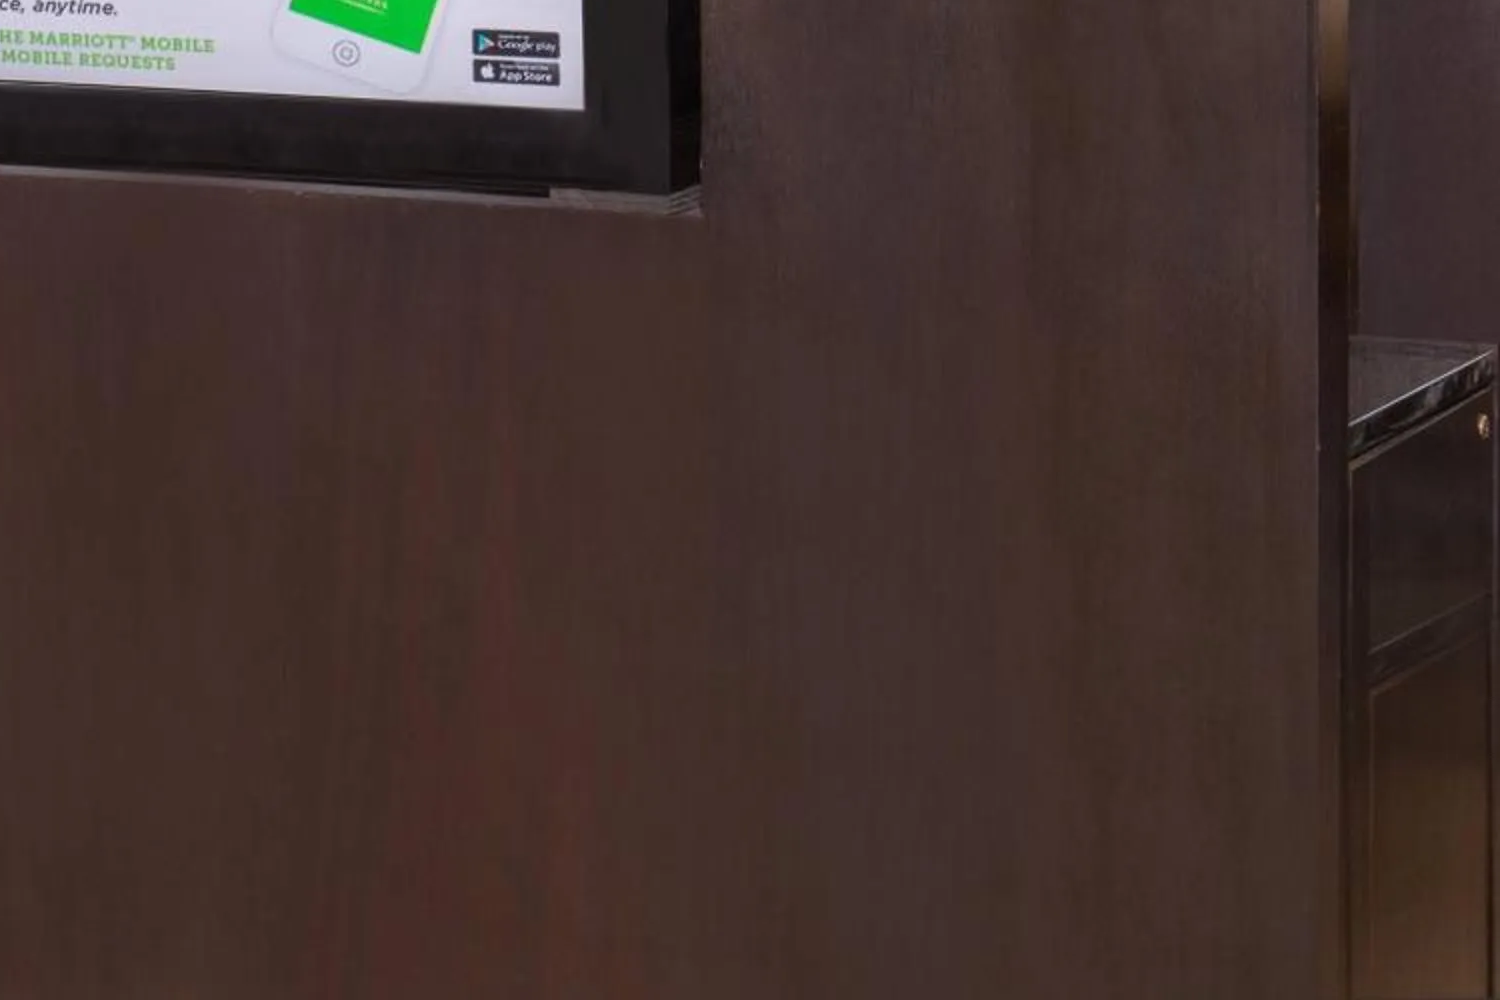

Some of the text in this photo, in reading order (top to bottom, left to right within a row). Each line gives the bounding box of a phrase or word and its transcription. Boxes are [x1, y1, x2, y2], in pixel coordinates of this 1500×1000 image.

[33, 0, 118, 16] anytime.
[141, 36, 215, 53] MOBILE
[497, 39, 533, 53] Google
[1, 50, 74, 67] MOBILE
[79, 53, 176, 71] REQUESTS
[500, 69, 553, 83] App Store
